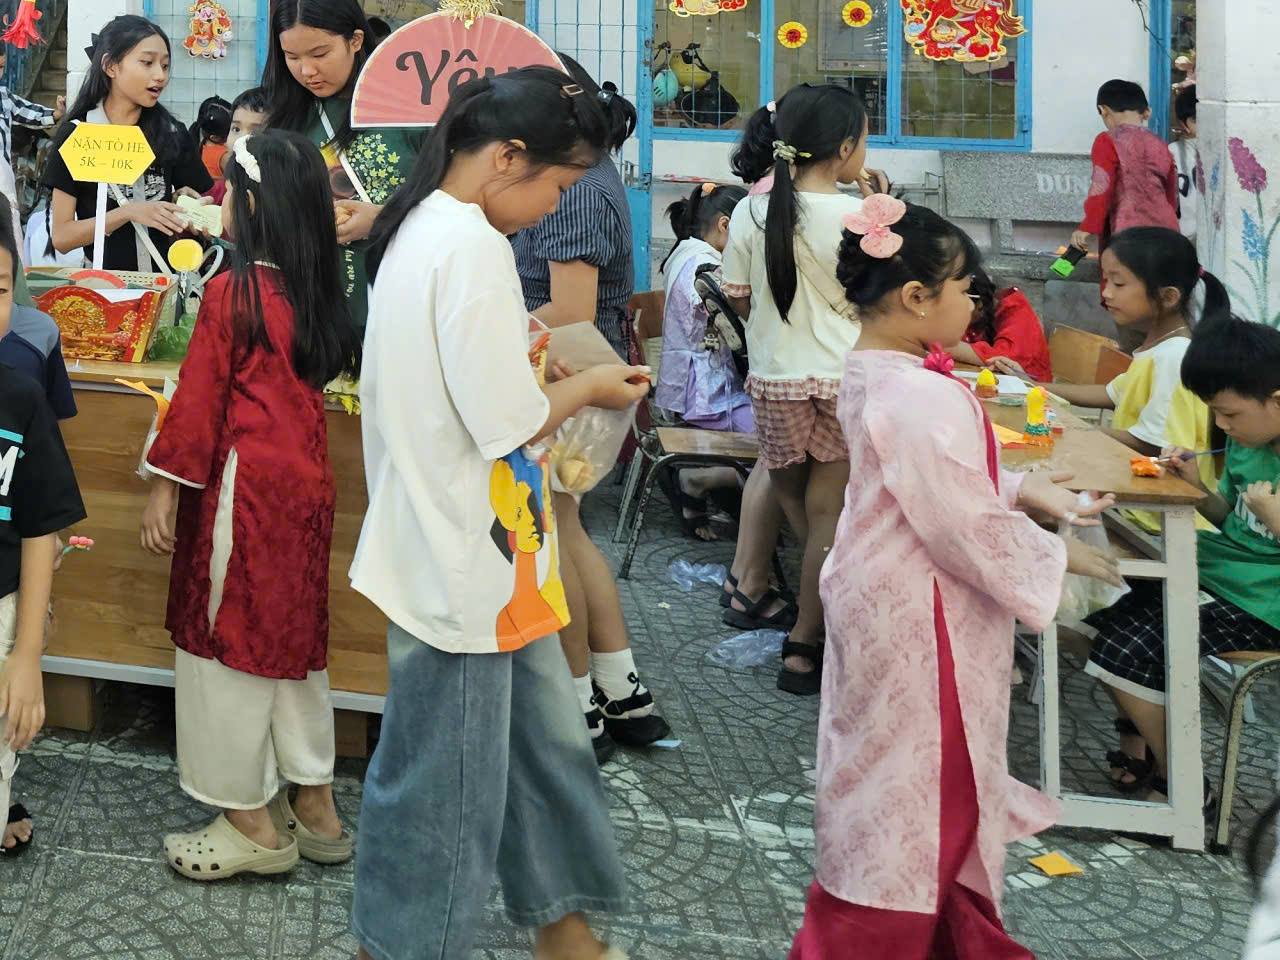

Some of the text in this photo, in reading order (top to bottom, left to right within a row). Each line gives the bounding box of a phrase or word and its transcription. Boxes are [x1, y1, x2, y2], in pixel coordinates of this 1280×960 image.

[127, 141, 145, 153] HE
[80, 156, 97, 167] 5K
[111, 158, 134, 170] 10K
